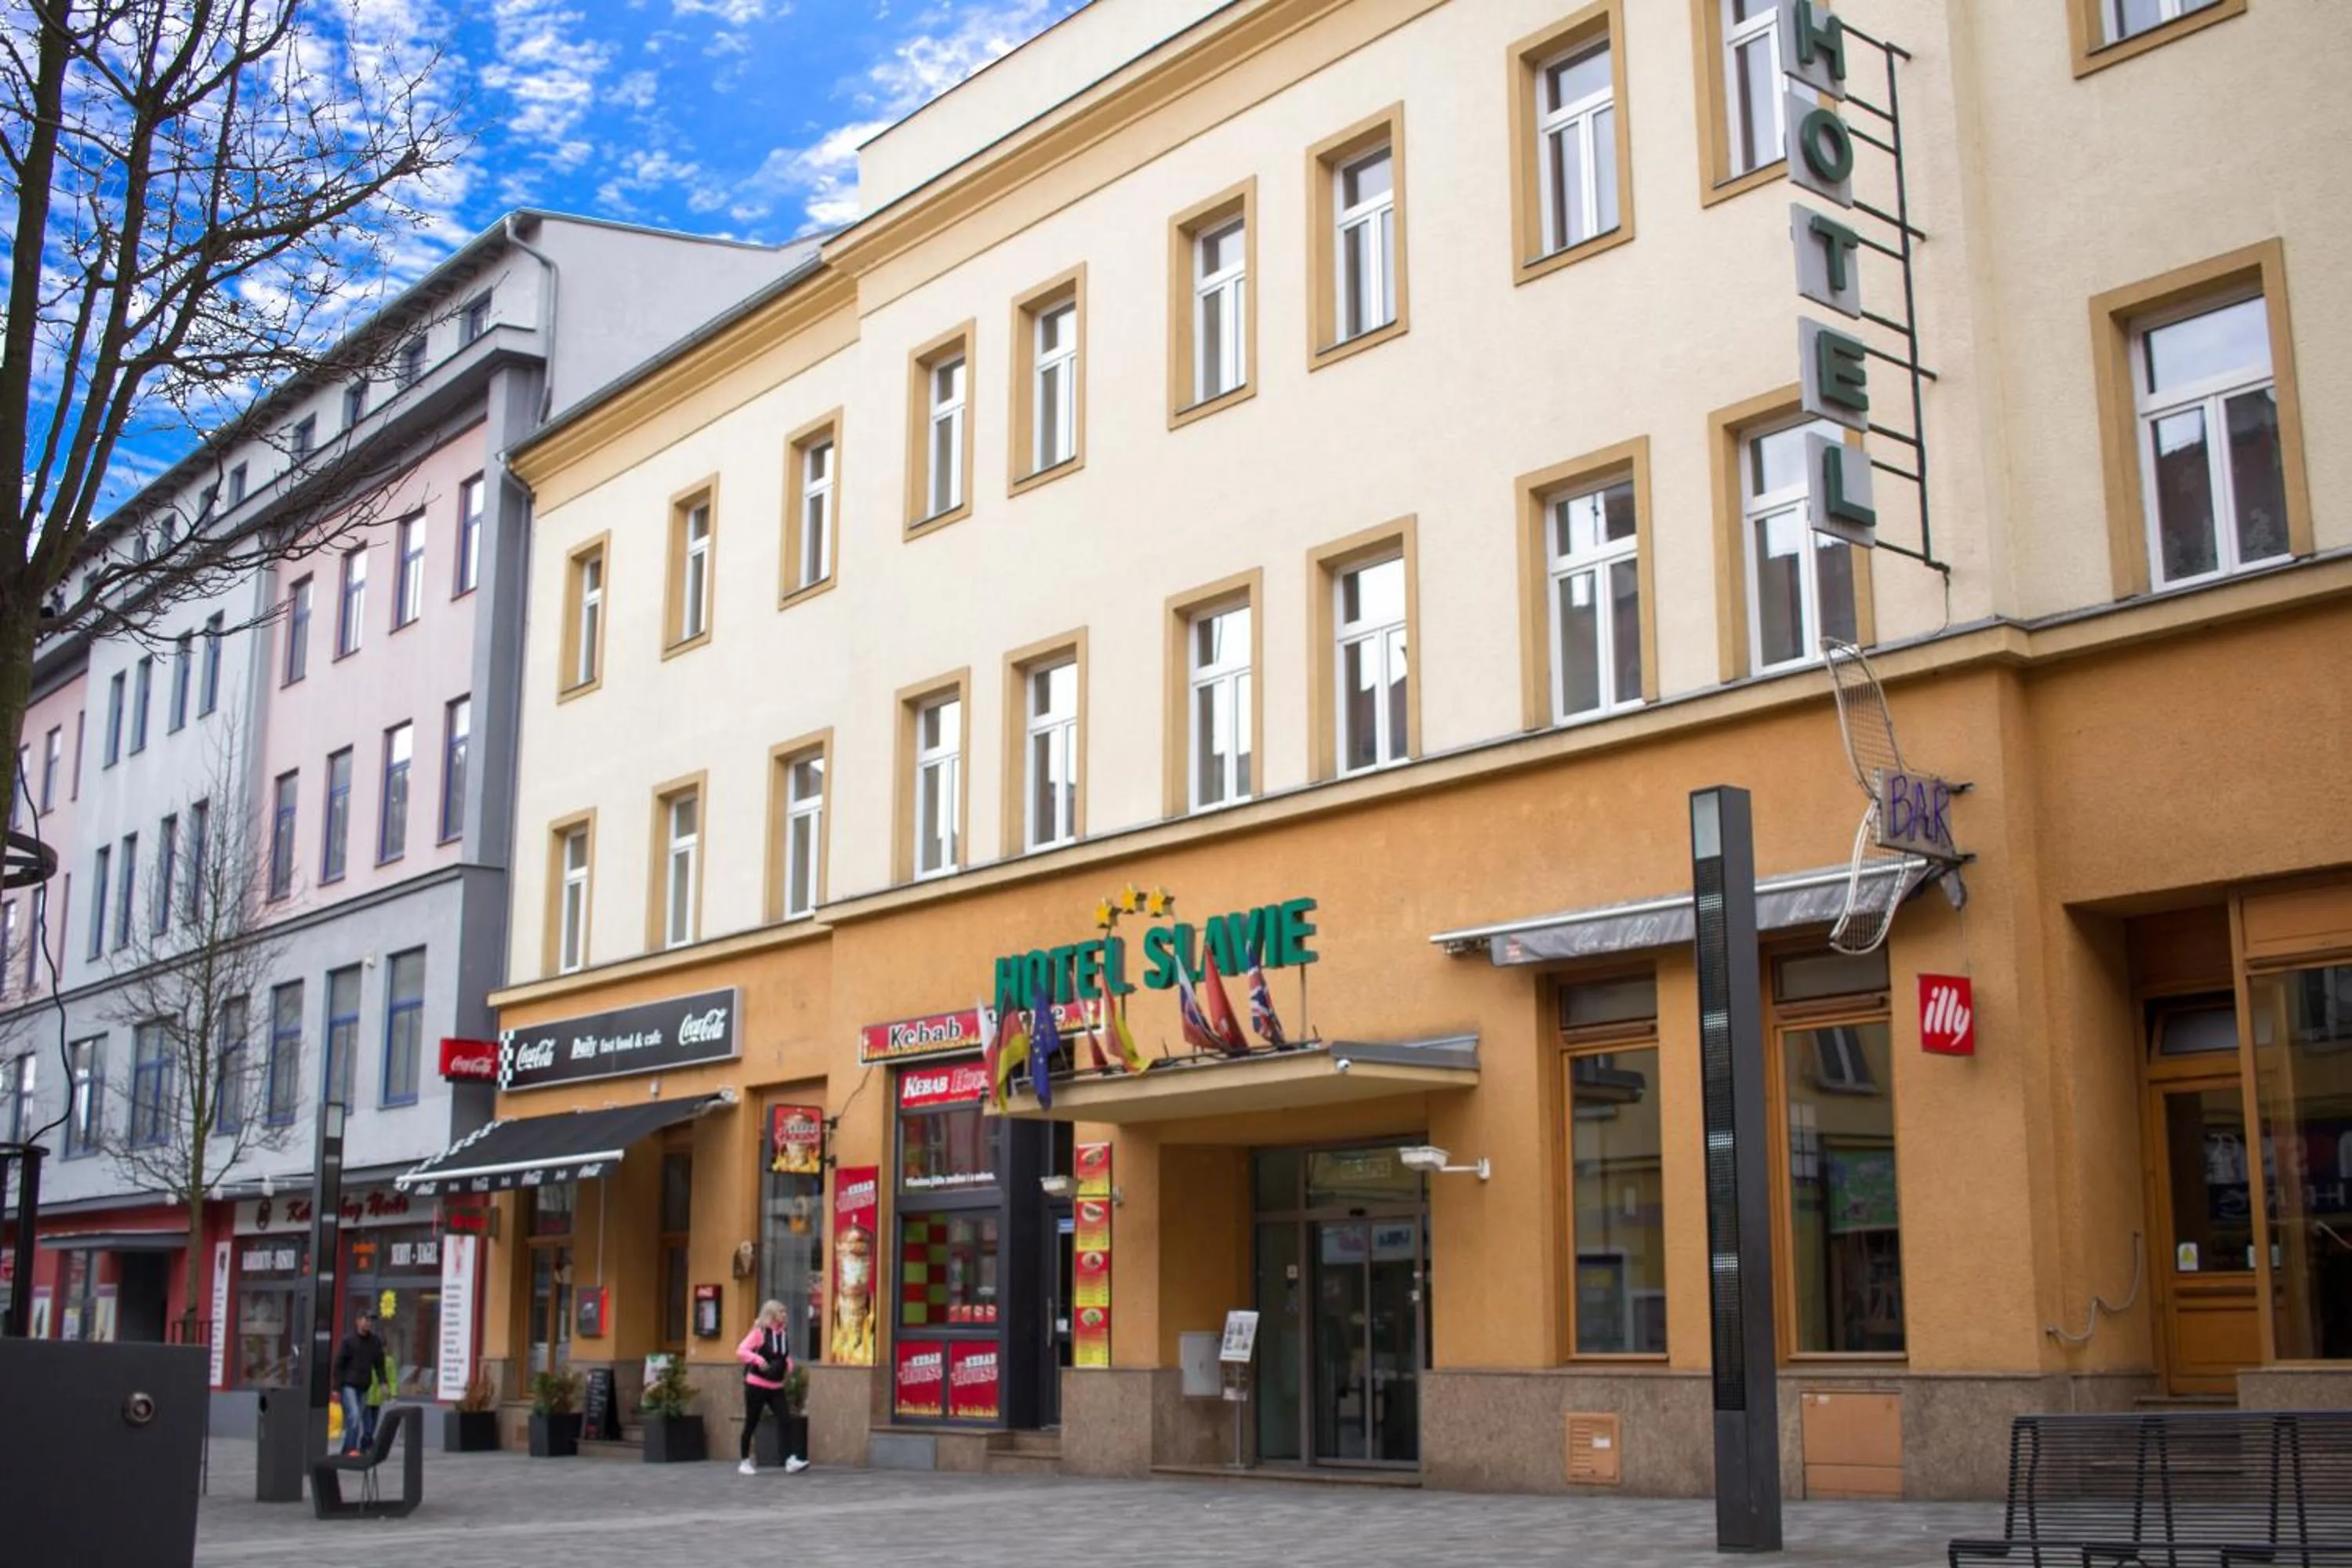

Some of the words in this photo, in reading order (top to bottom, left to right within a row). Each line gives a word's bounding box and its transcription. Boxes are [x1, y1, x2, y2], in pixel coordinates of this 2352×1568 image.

[1798, 0, 1876, 528] HOTEL
[1889, 775, 1951, 844] BAR
[994, 936, 1137, 1014] HOTEL
[1144, 897, 1319, 989] SLAVIE
[889, 1015, 964, 1049] Kebab
[1923, 985, 1970, 1047] illy
